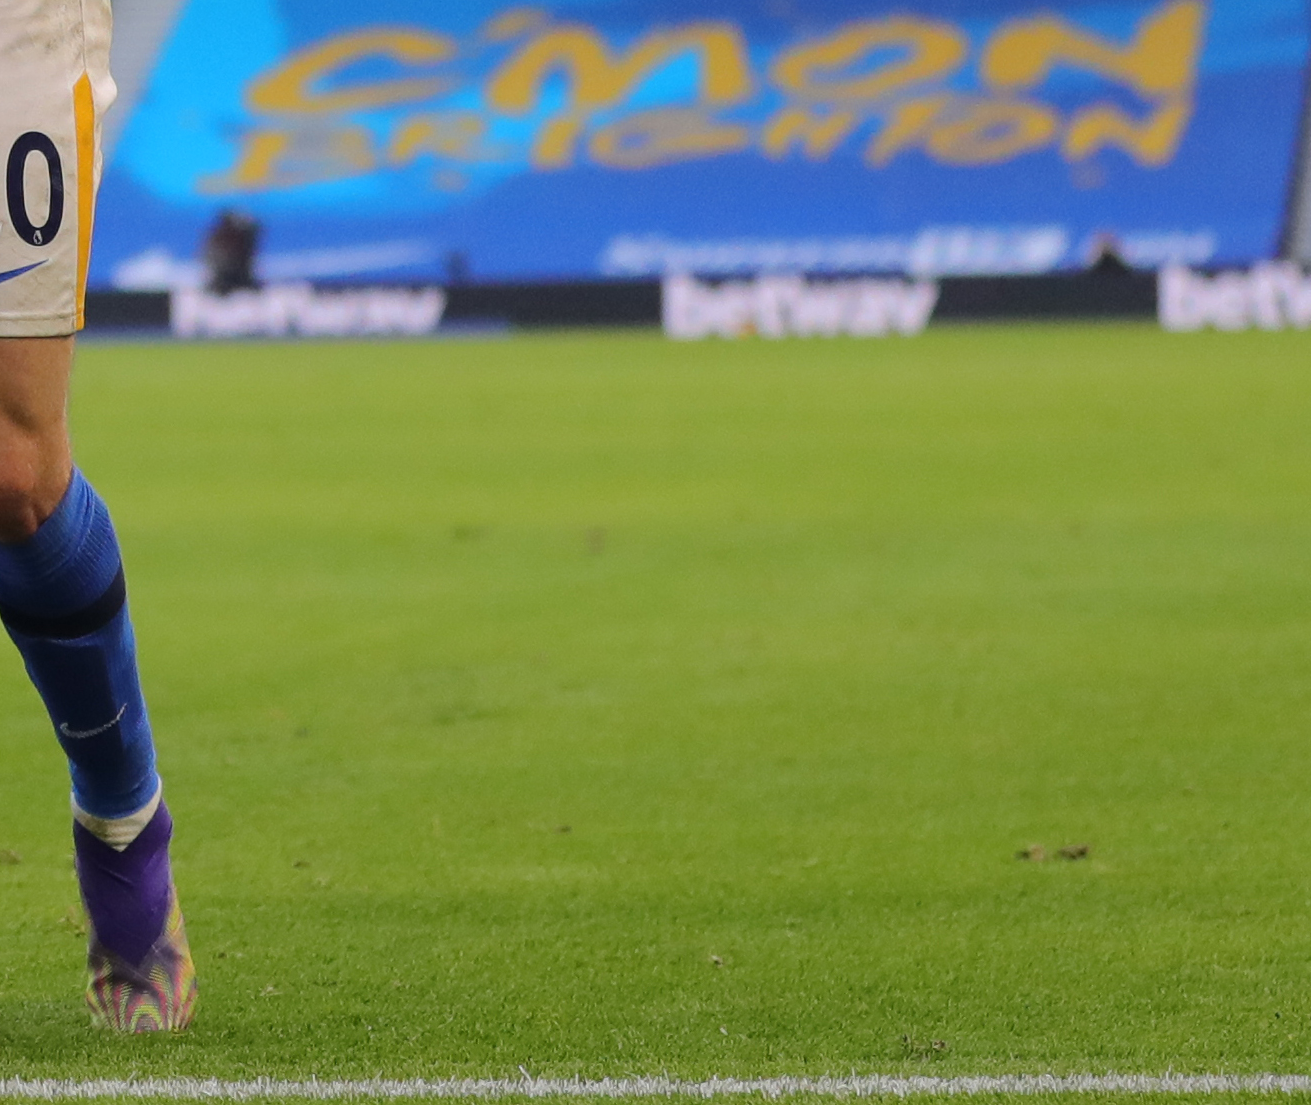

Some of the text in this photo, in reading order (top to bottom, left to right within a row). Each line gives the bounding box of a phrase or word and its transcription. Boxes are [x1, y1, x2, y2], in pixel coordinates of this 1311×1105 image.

[194, 96, 1192, 192] BRIGHTON
[171, 280, 447, 336] betway
[661, 271, 939, 340] betway
